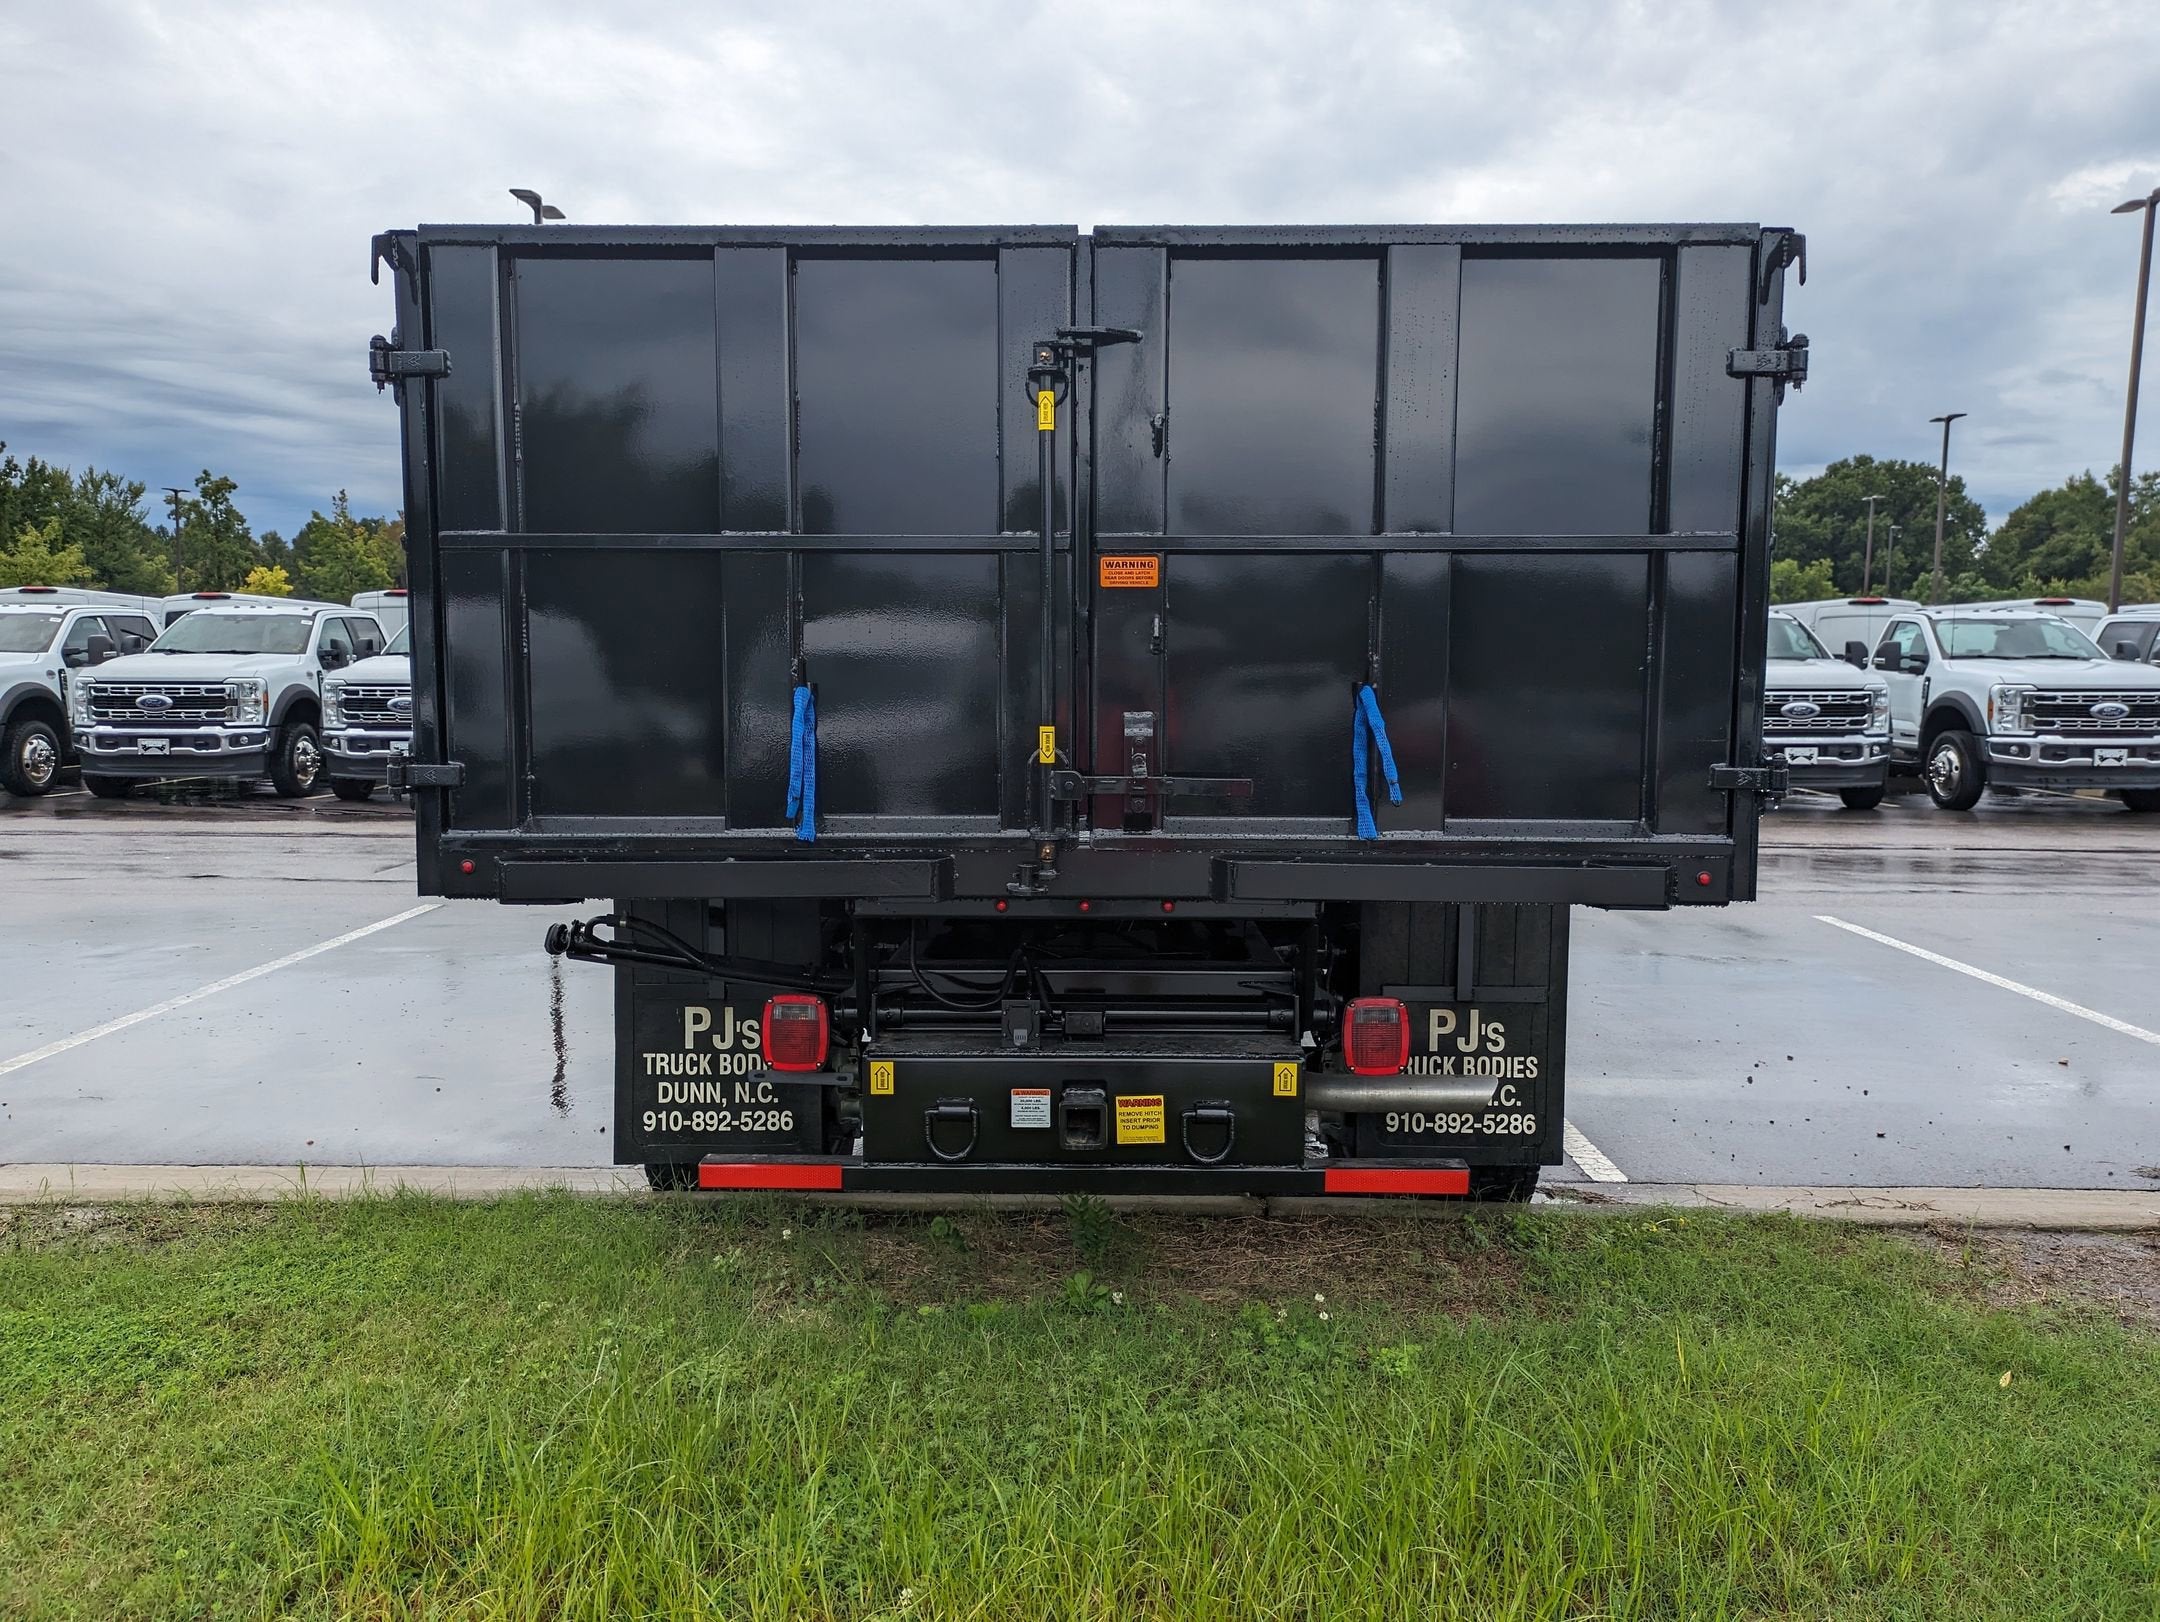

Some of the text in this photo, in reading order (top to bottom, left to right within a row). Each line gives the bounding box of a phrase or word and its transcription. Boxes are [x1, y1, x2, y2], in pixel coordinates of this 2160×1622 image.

[1105, 561, 1154, 569] WARNING
[643, 1053, 772, 1075] TRUCK BOD
[1402, 1056, 1538, 1079] RUCK BODIES
[658, 1082, 779, 1107] DUNN, N.C.
[1118, 1098, 1162, 1107] WARNING
[1487, 1084, 1522, 1107] .C.
[643, 1110, 794, 1132] 910-892-5286
[1385, 1112, 1537, 1134] 910-892-5286
